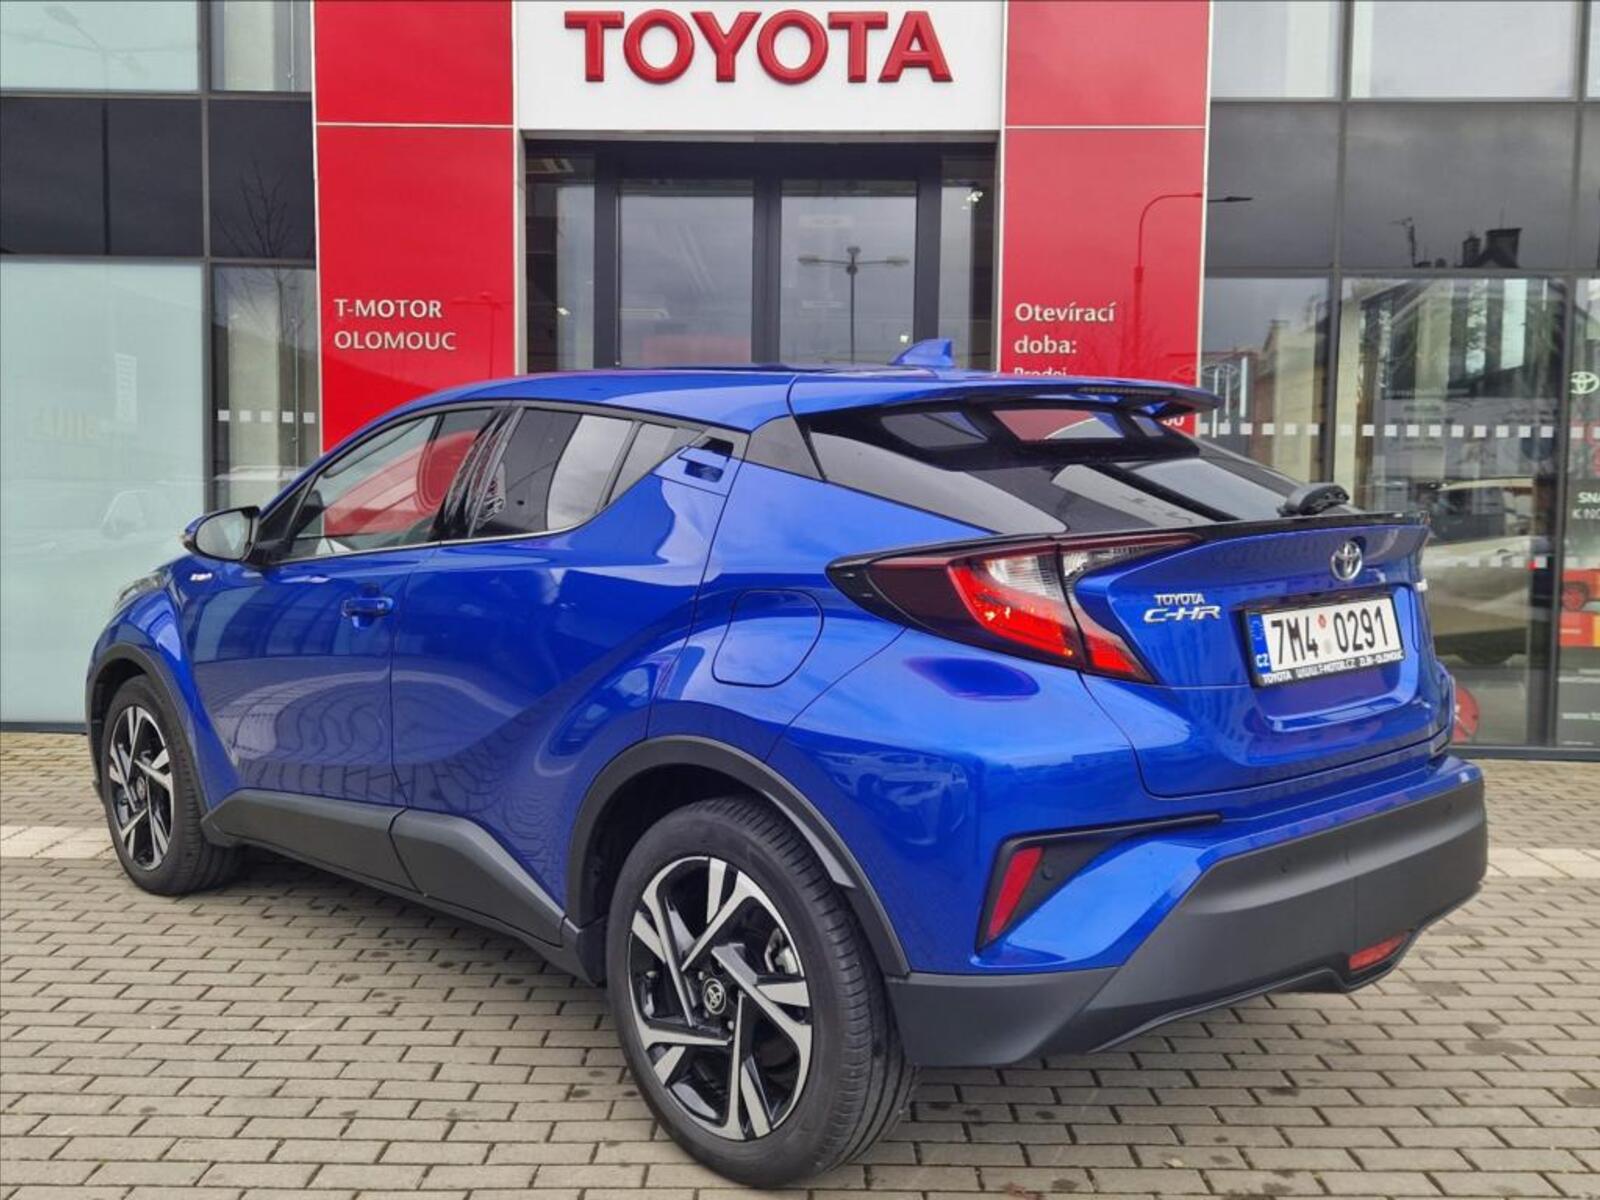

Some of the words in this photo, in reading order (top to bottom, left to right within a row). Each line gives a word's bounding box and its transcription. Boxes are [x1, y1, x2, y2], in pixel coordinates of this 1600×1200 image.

[564, 9, 953, 85] TOYOTA
[333, 298, 443, 318] T-MOTOR
[1014, 302, 1117, 323] Otevírací
[334, 330, 457, 351] OLOMOUC
[1013, 335, 1077, 354] doba:
[1153, 592, 1206, 606] TOYOTA
[1144, 605, 1221, 625] C-HR
[1271, 615, 1319, 665] 7M4
[1333, 606, 1388, 653] 0291
[1256, 653, 1270, 667] CZ
